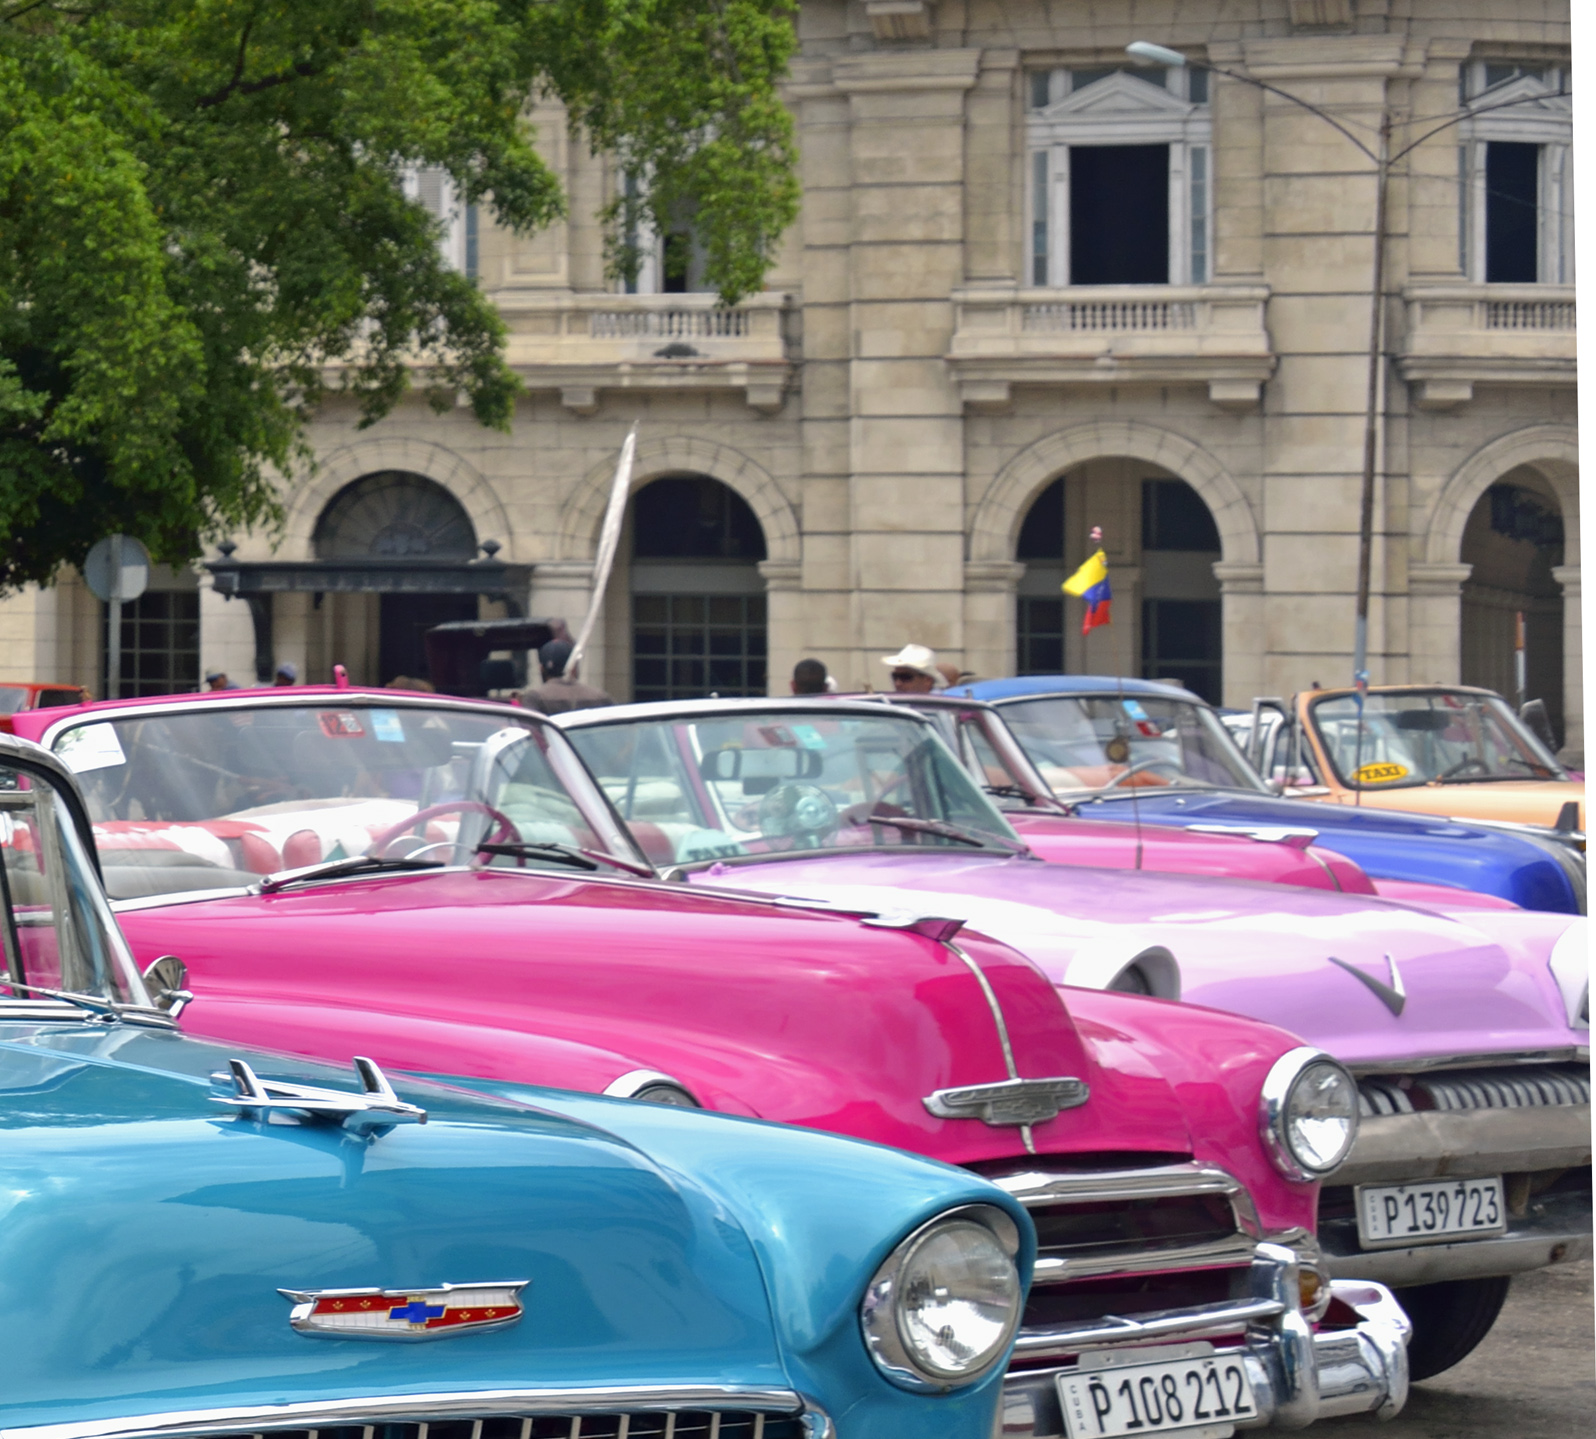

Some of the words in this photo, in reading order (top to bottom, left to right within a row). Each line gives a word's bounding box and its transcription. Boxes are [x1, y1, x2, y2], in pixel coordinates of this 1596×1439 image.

[1359, 766, 1401, 779] TAXI
[1384, 1196, 1398, 1233] P
[1405, 1191, 1450, 1231] 139
[1455, 1186, 1498, 1226] 723
[1070, 1385, 1087, 1431] CUBA
[1088, 1381, 1112, 1432] P
[1119, 1374, 1183, 1429] 108
[1186, 1366, 1252, 1419] 212
